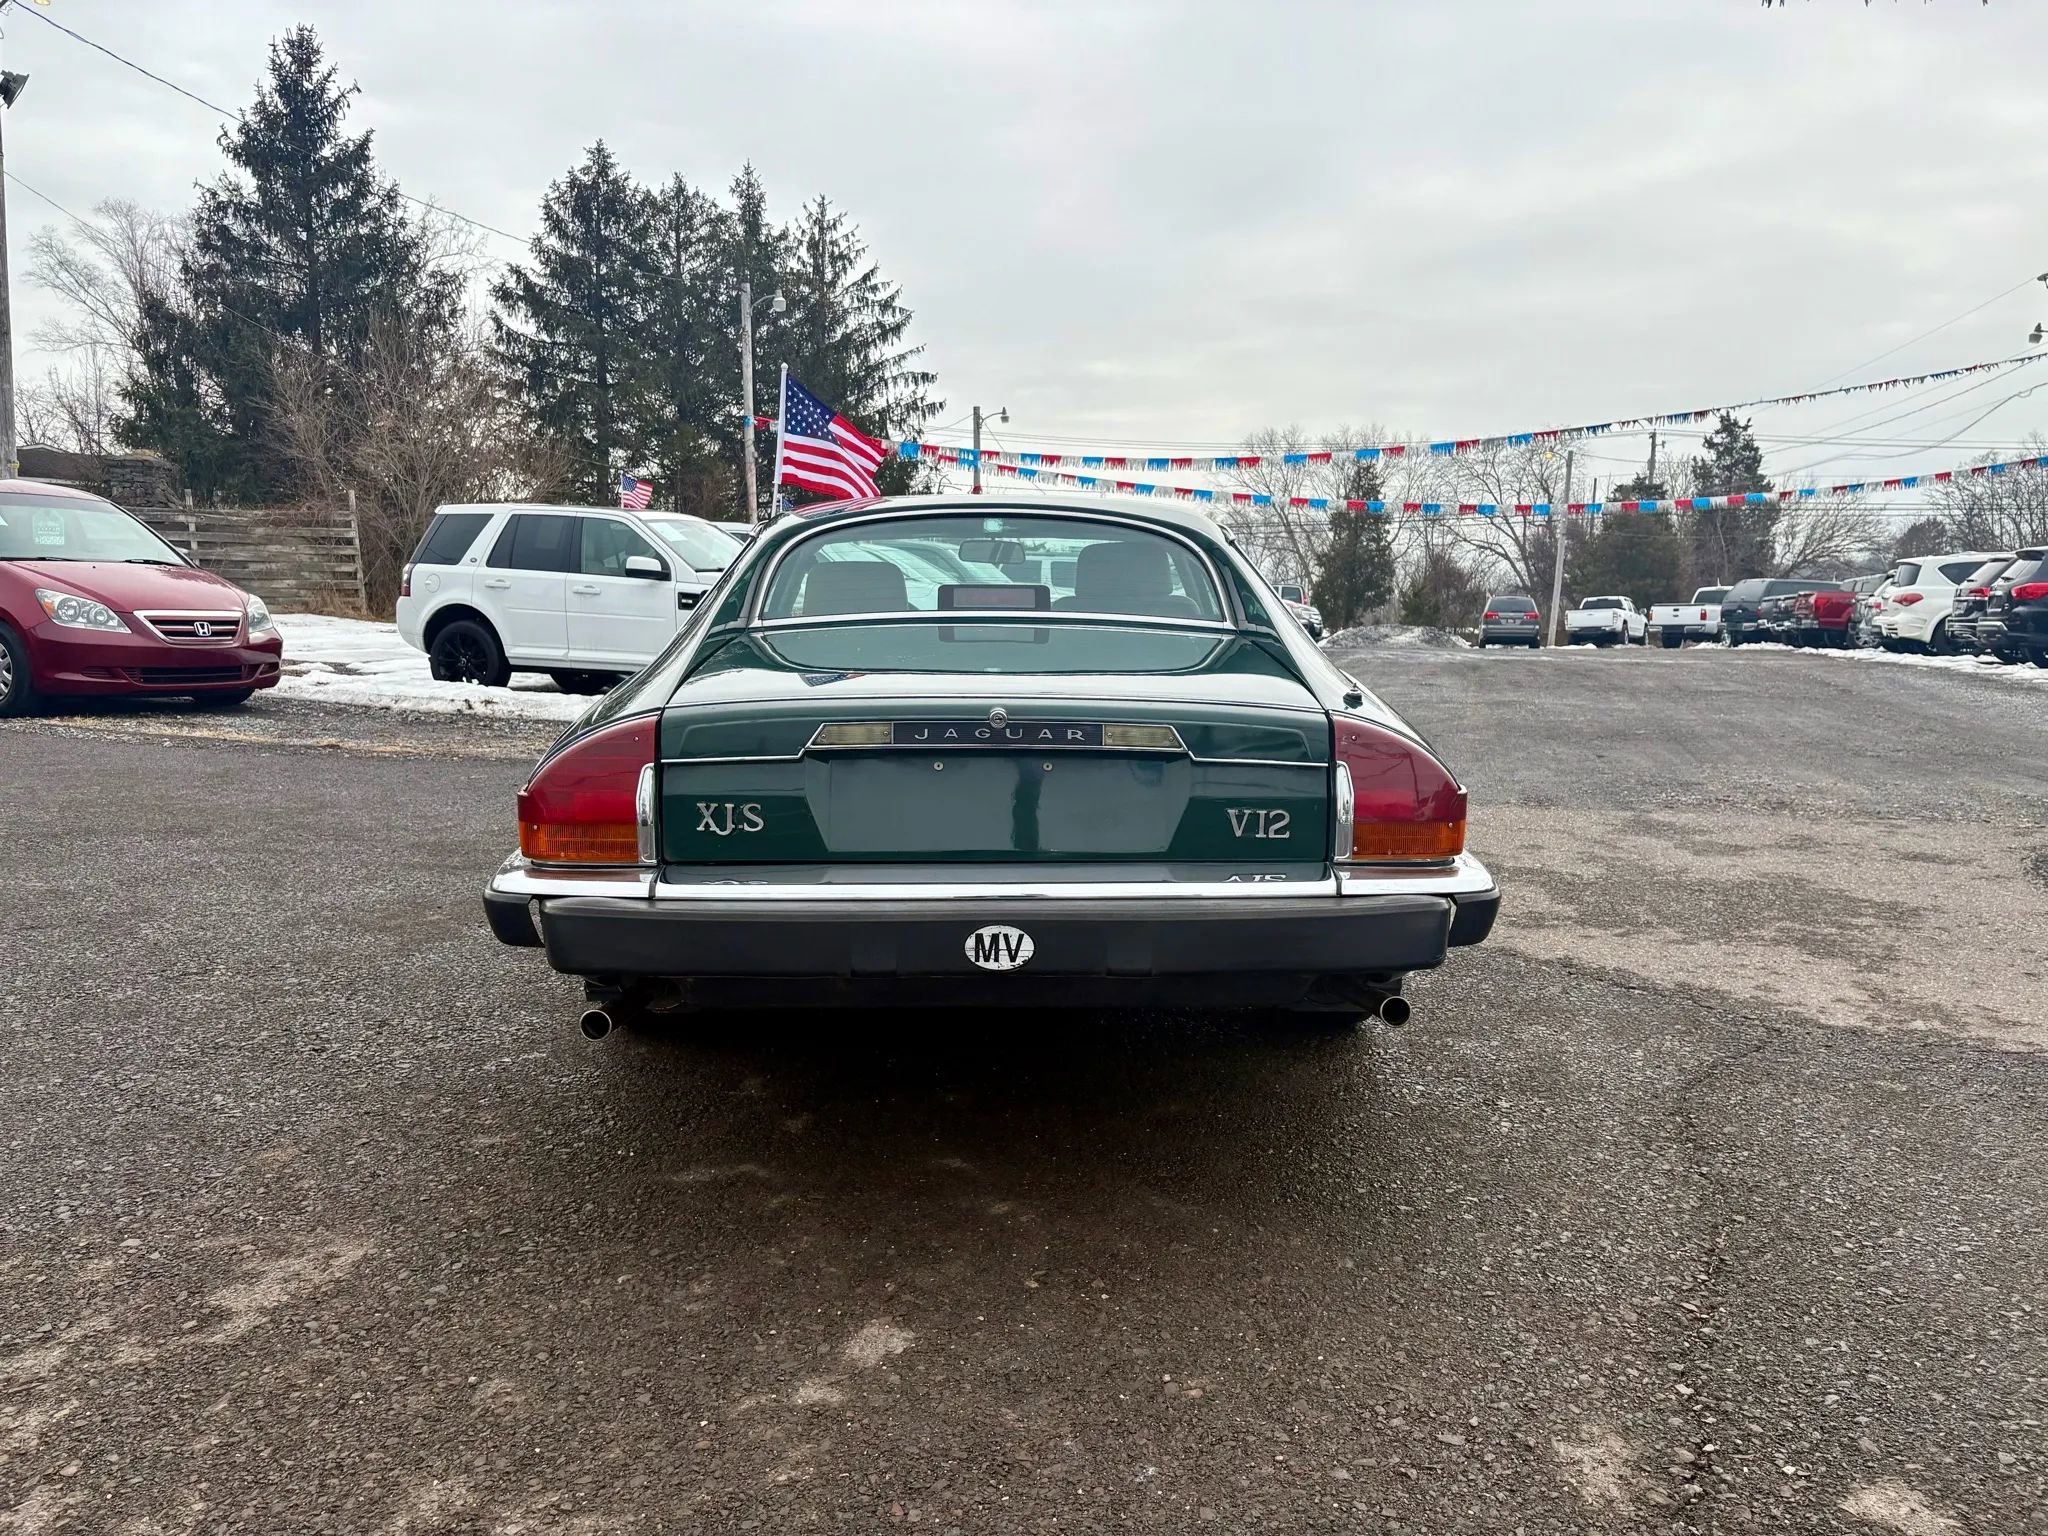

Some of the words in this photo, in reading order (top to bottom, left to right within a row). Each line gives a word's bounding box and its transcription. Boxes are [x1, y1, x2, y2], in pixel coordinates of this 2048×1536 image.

[914, 728, 1086, 741] JAGUAR
[1226, 808, 1291, 839] V12
[974, 932, 1025, 963] MV
